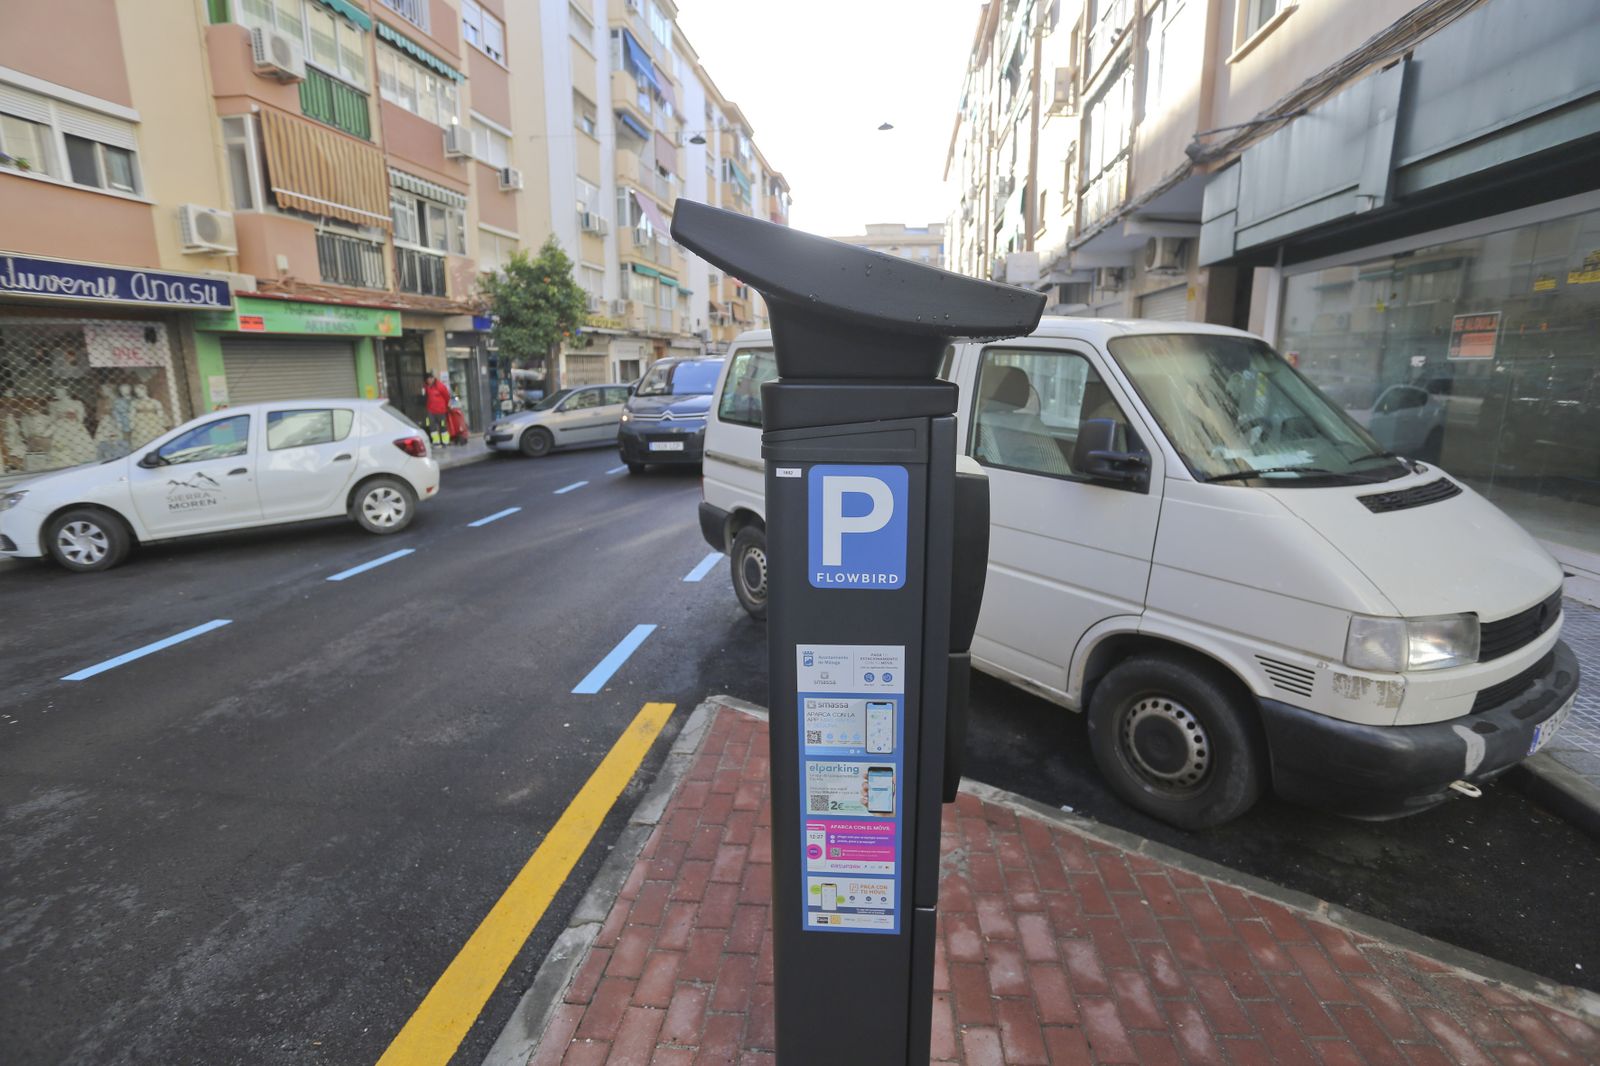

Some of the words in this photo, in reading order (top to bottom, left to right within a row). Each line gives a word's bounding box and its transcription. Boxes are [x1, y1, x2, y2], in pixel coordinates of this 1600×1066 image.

[822, 475, 894, 567] P
[816, 572, 898, 584] FLOWBIRD
[809, 763, 860, 775] elparking
[830, 800, 845, 811] 2€
